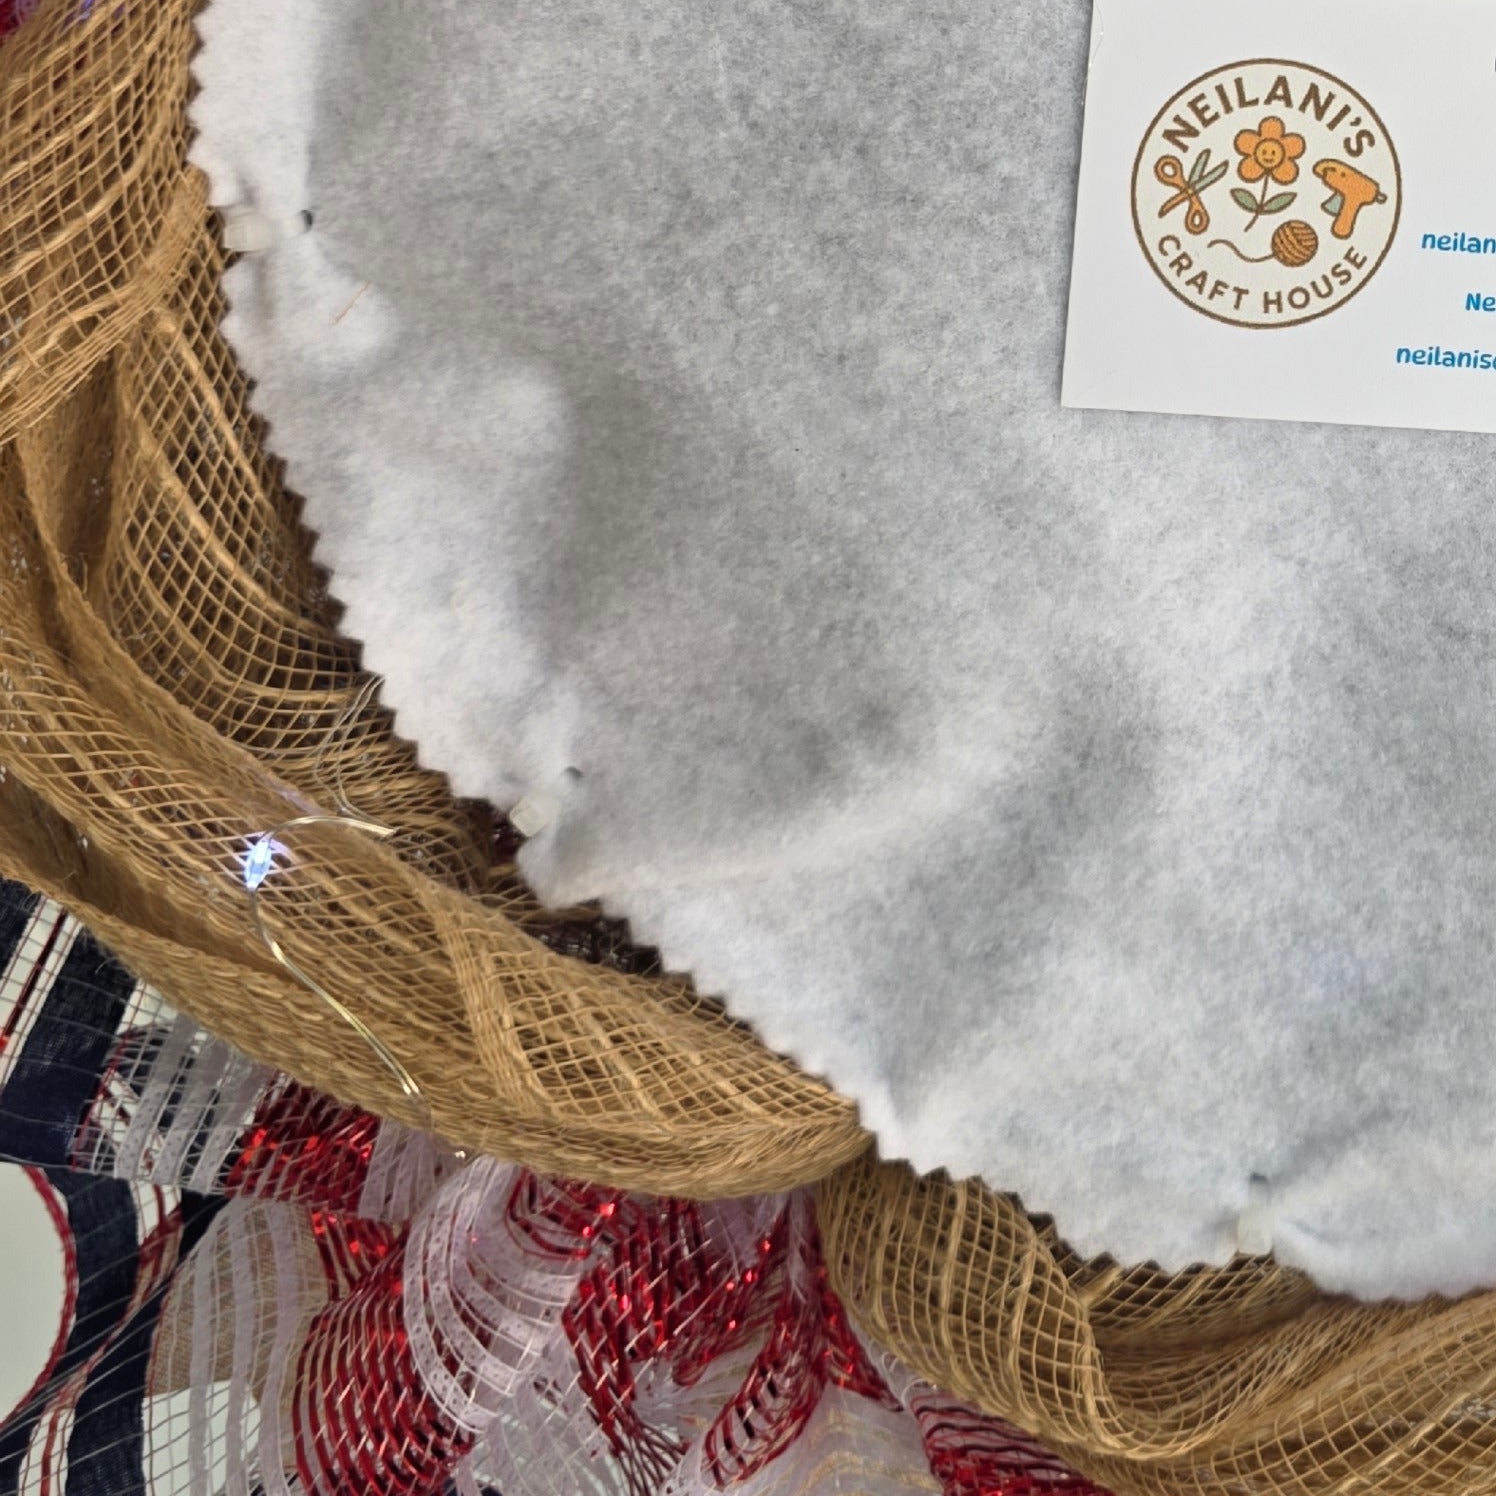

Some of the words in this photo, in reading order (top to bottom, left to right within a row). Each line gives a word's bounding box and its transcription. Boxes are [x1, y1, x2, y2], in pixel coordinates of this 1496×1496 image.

[1162, 75, 1376, 157] NEILANI'S
[1158, 234, 1249, 310] CRAFT
[1263, 246, 1367, 314] HOUSE
